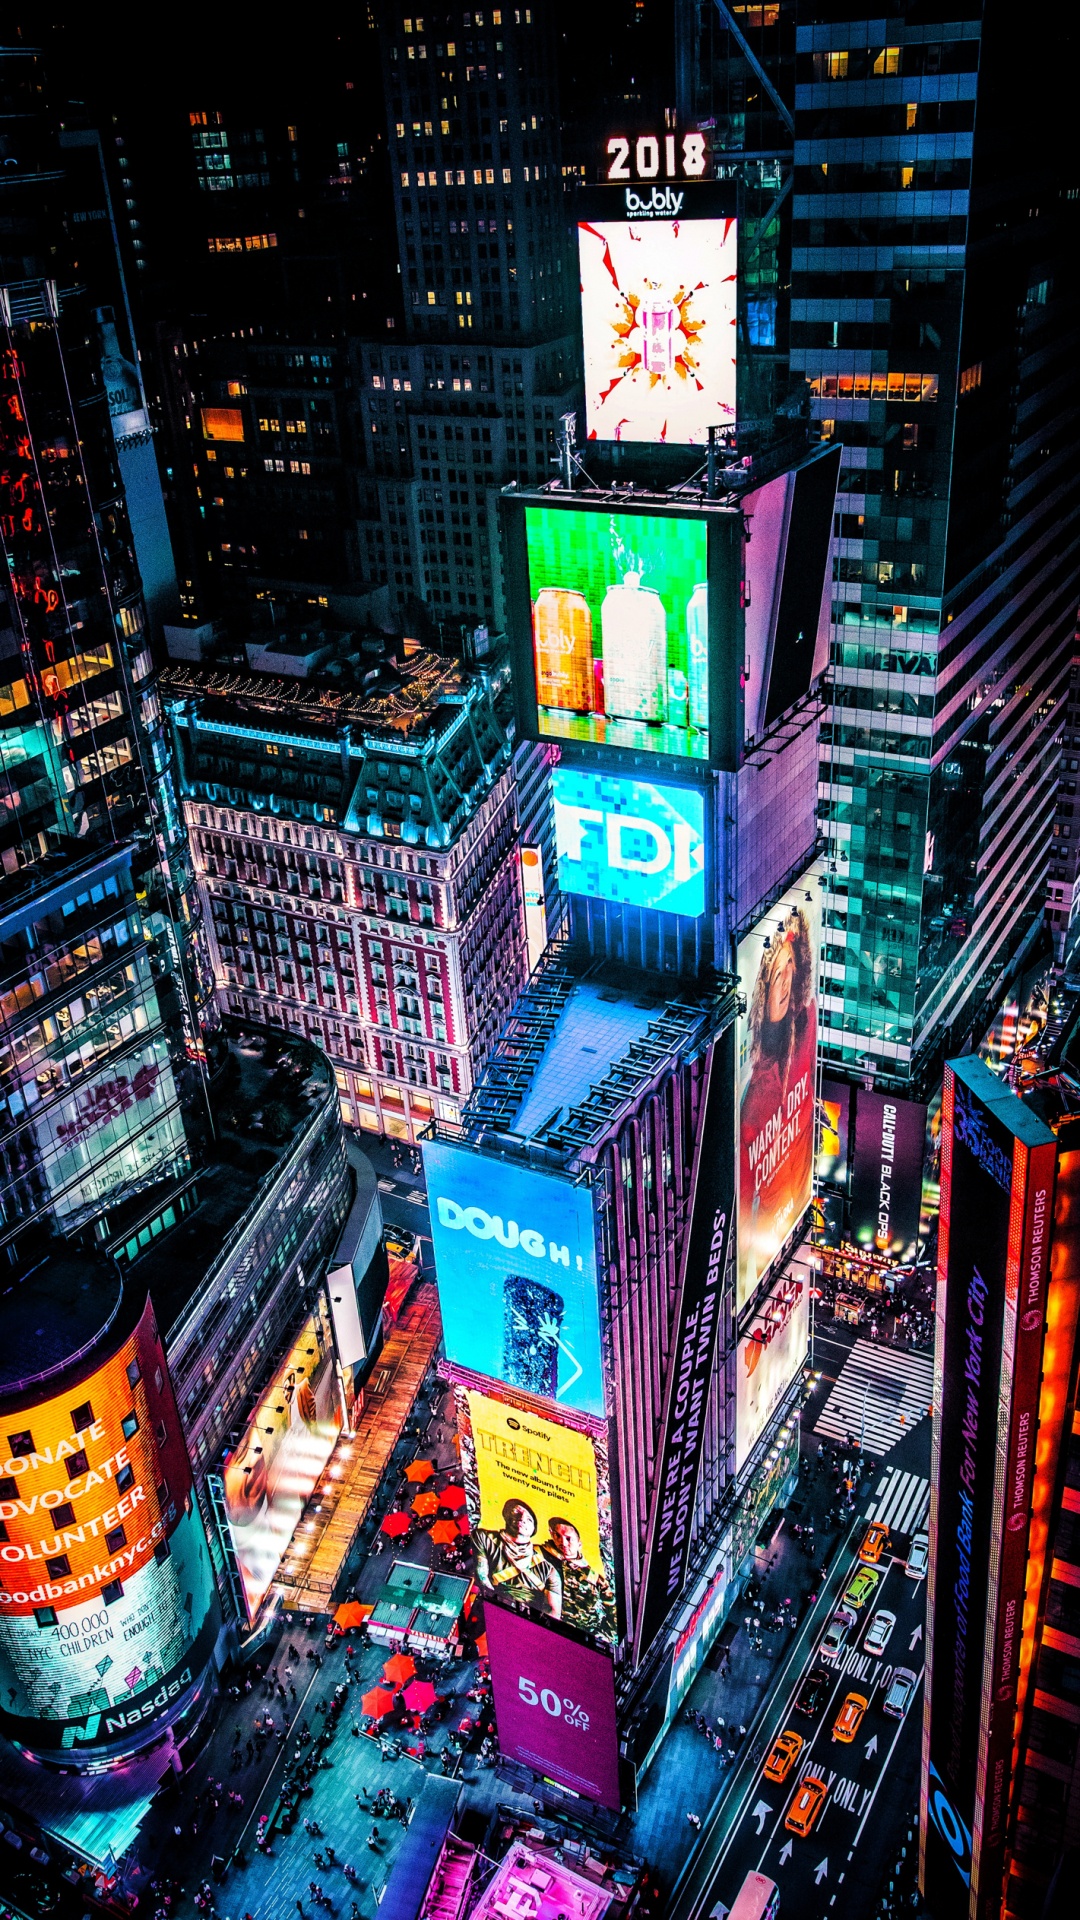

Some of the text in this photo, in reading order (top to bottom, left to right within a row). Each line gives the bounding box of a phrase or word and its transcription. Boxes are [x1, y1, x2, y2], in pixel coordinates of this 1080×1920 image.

[607, 132, 706, 179] 2018
[625, 186, 684, 215] bubly
[748, 1105, 784, 1171] WARM.
[786, 1072, 808, 1119] DRY.
[754, 1109, 801, 1192] CONTENT.
[878, 1164, 893, 1210] BLACK
[437, 1197, 583, 1271] DOUGH!
[877, 1211, 890, 1240] OPS
[1028, 1189, 1047, 1305] THOMSON REUTERS
[967, 1264, 989, 1326] City
[696, 1292, 716, 1369] TWIN
[965, 1325, 983, 1388] York
[674, 1301, 701, 1419] COUPLE.
[522, 1424, 551, 1442] Spotify
[671, 1422, 685, 1444] A
[684, 1377, 705, 1459] WANT
[961, 1386, 980, 1452] New
[0, 1418, 106, 1477] ONATE
[477, 1428, 591, 1492] TRENCH
[959, 1446, 976, 1495] For
[1013, 1412, 1030, 1508] THOMSON REUTERS
[495, 1460, 575, 1498] The new album from
[502, 1471, 570, 1504] twenty one pilots
[673, 1465, 693, 1547] DON'T
[957, 1489, 974, 1556] Bank
[667, 1548, 682, 1596] WE
[954, 1543, 971, 1613] Food
[28, 1626, 114, 1661] NYC CHILDREN
[51, 1609, 110, 1641] 400,000
[119, 1613, 135, 1627] WHO
[123, 1613, 156, 1641] ENOUGH
[1002, 1600, 1016, 1682] THOMSON REUTERS
[847, 1652, 883, 1685] ONLY
[105, 1667, 192, 1734] Nasdaq
[518, 1676, 590, 1723] 50%
[564, 1714, 590, 1731] OFF
[834, 1777, 872, 1816] ONLY
